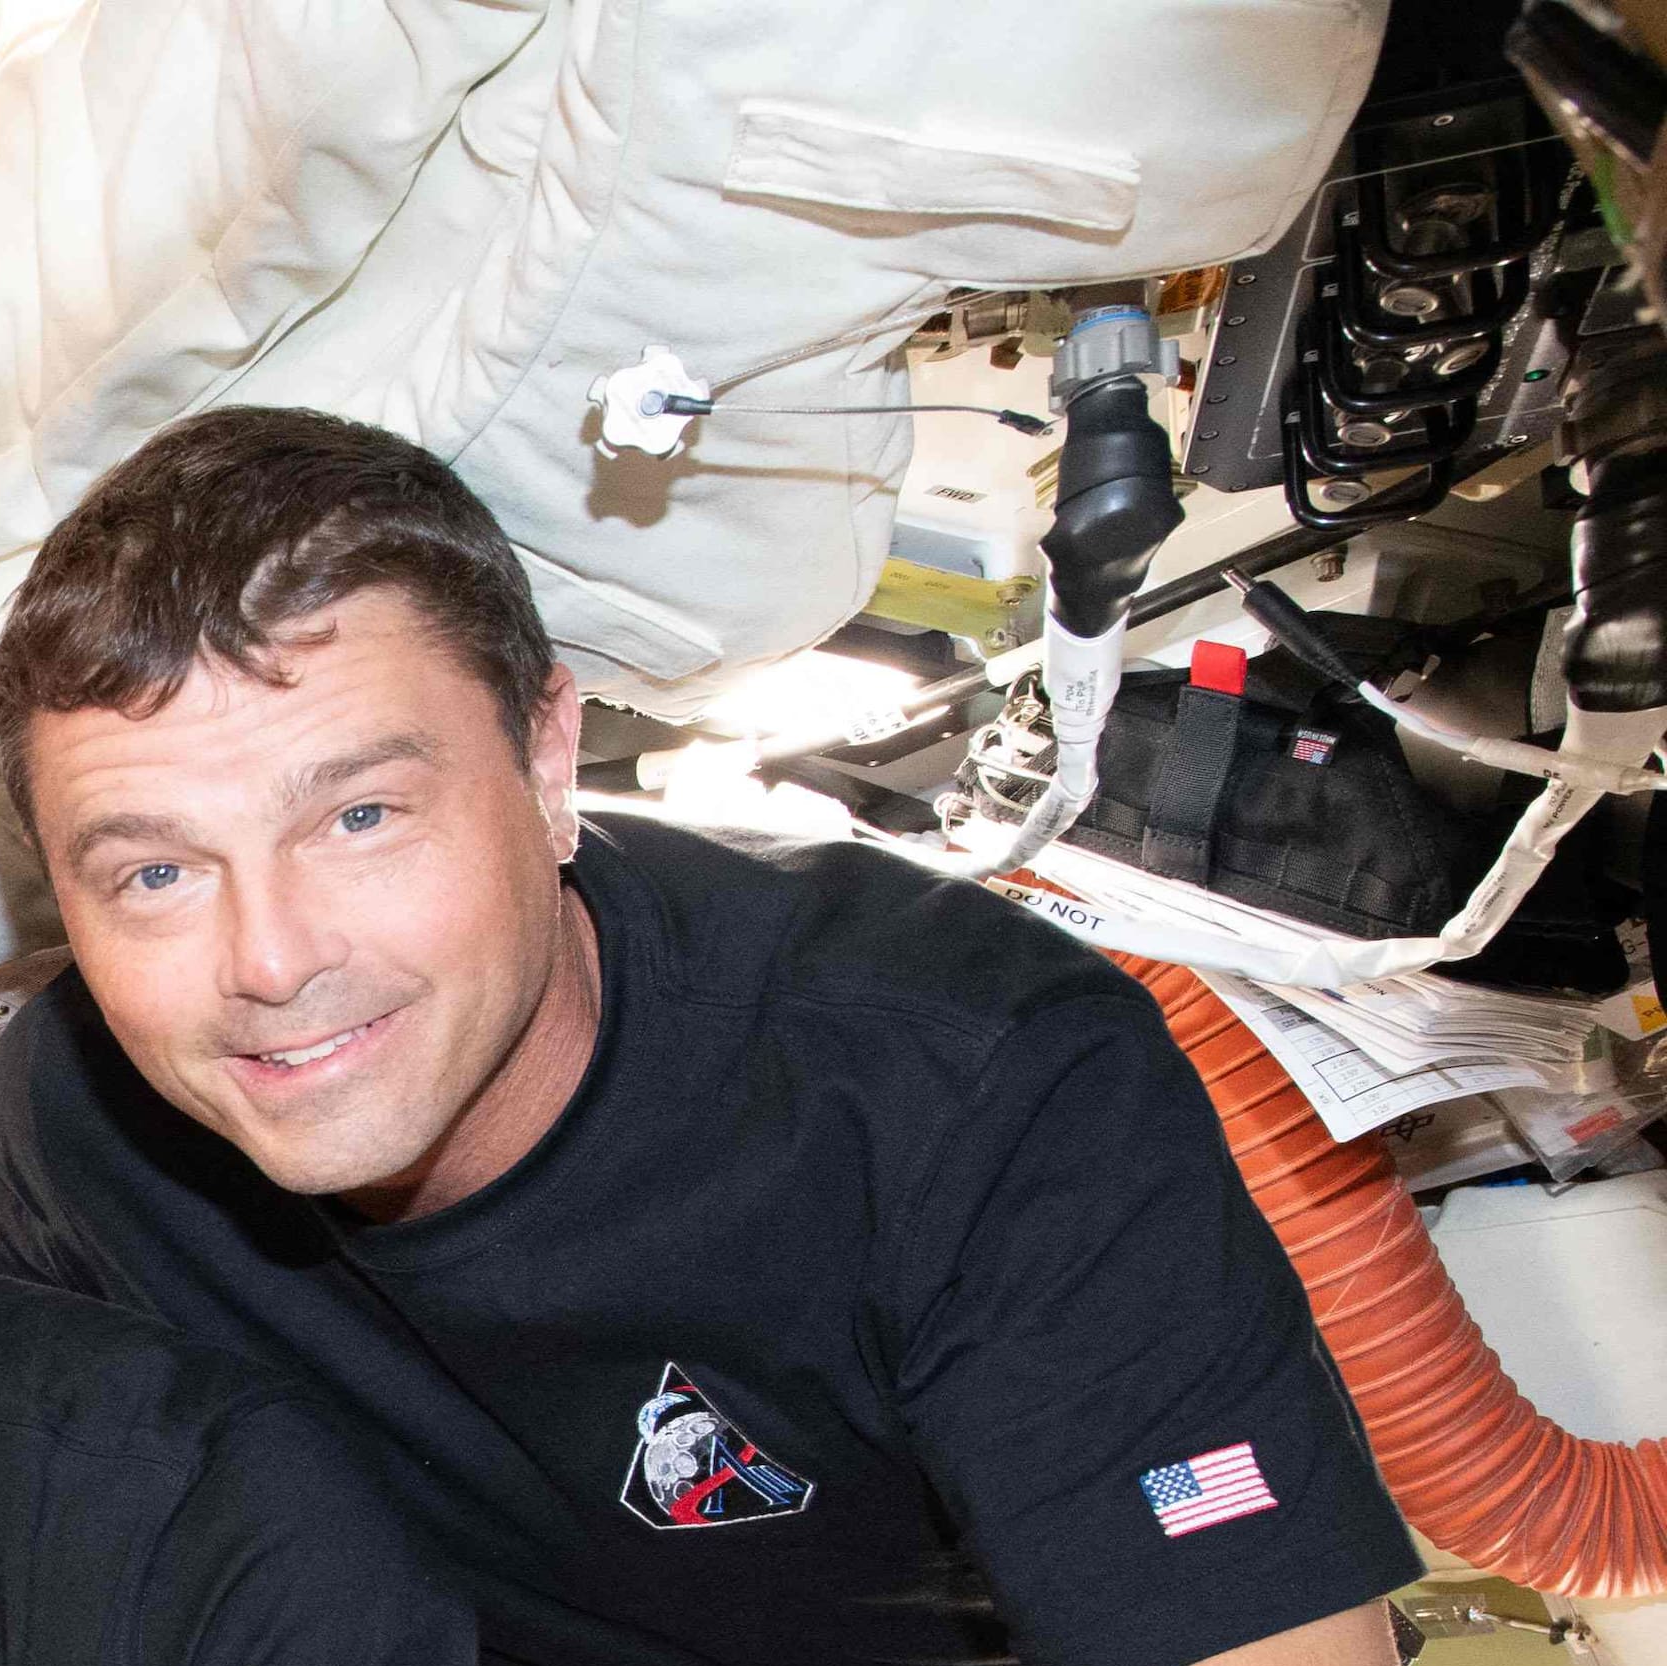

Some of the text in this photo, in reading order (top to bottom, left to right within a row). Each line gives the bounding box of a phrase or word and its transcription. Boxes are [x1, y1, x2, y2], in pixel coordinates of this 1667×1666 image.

[936, 487, 975, 501] FWD
[1005, 888, 1106, 930] DO NOT
